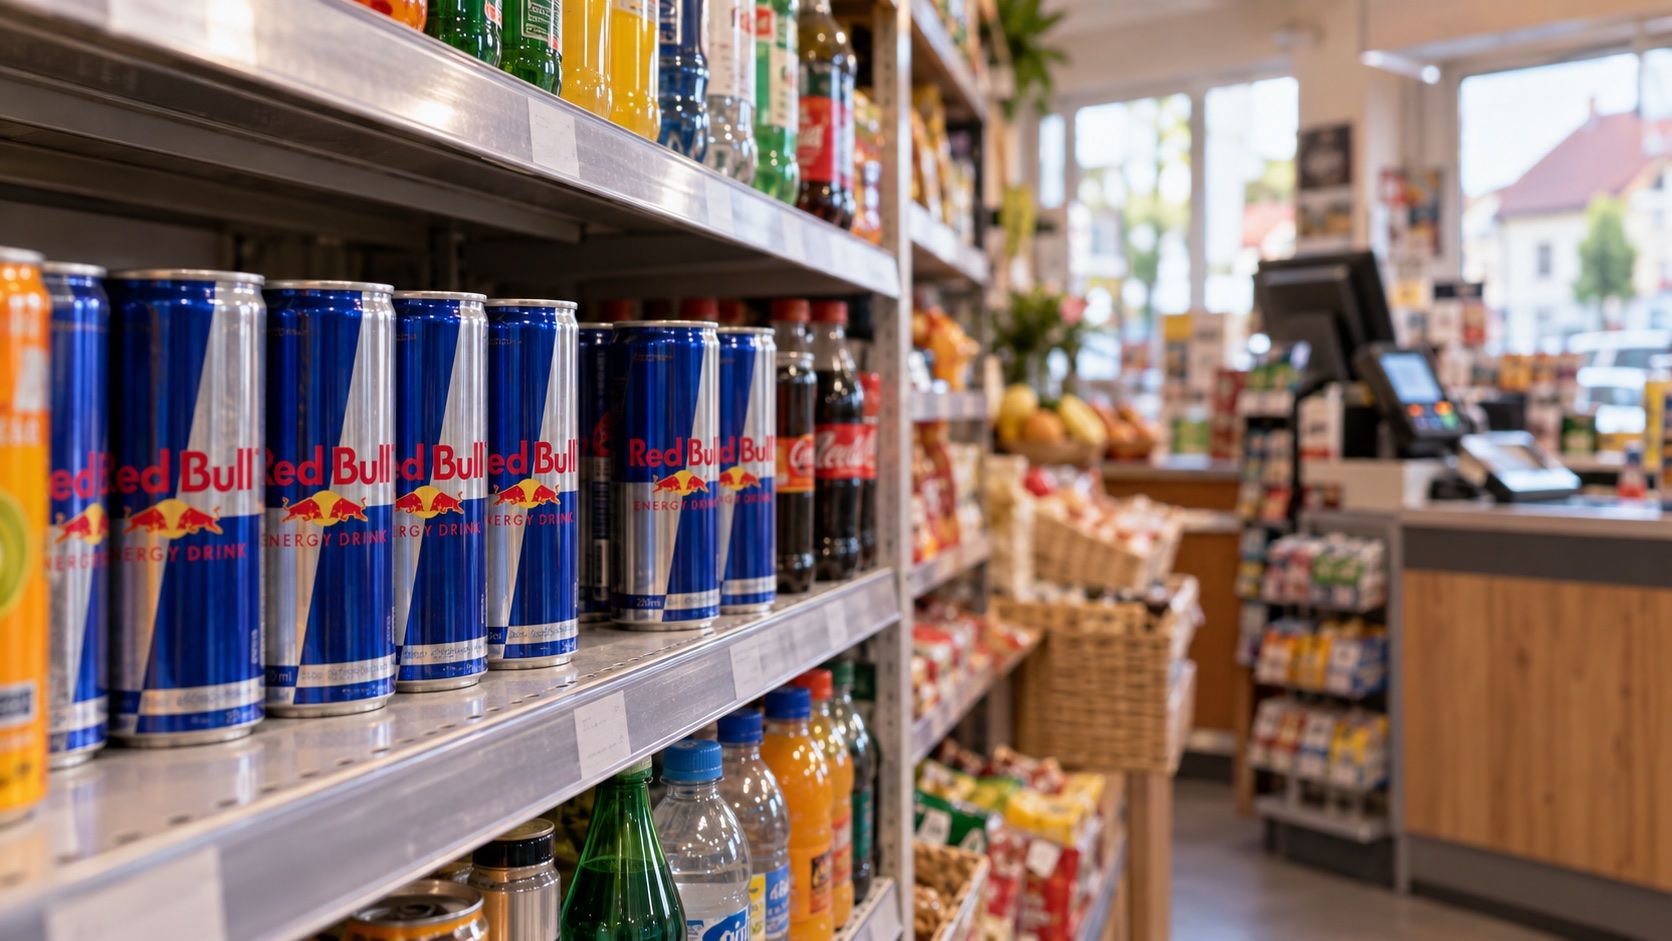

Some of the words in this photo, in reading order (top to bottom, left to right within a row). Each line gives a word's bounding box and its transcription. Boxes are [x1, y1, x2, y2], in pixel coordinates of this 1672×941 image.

[333, 444, 391, 485] Bull
[433, 442, 484, 481] Bull
[488, 439, 528, 475] ed
[534, 439, 577, 475] Bull
[629, 437, 682, 467] Red
[180, 448, 253, 493] Bull
[438, 521, 481, 536] DRINK
[538, 512, 574, 525] DRINK
[187, 543, 247, 562] DRINK
[339, 529, 387, 546] DRINK
